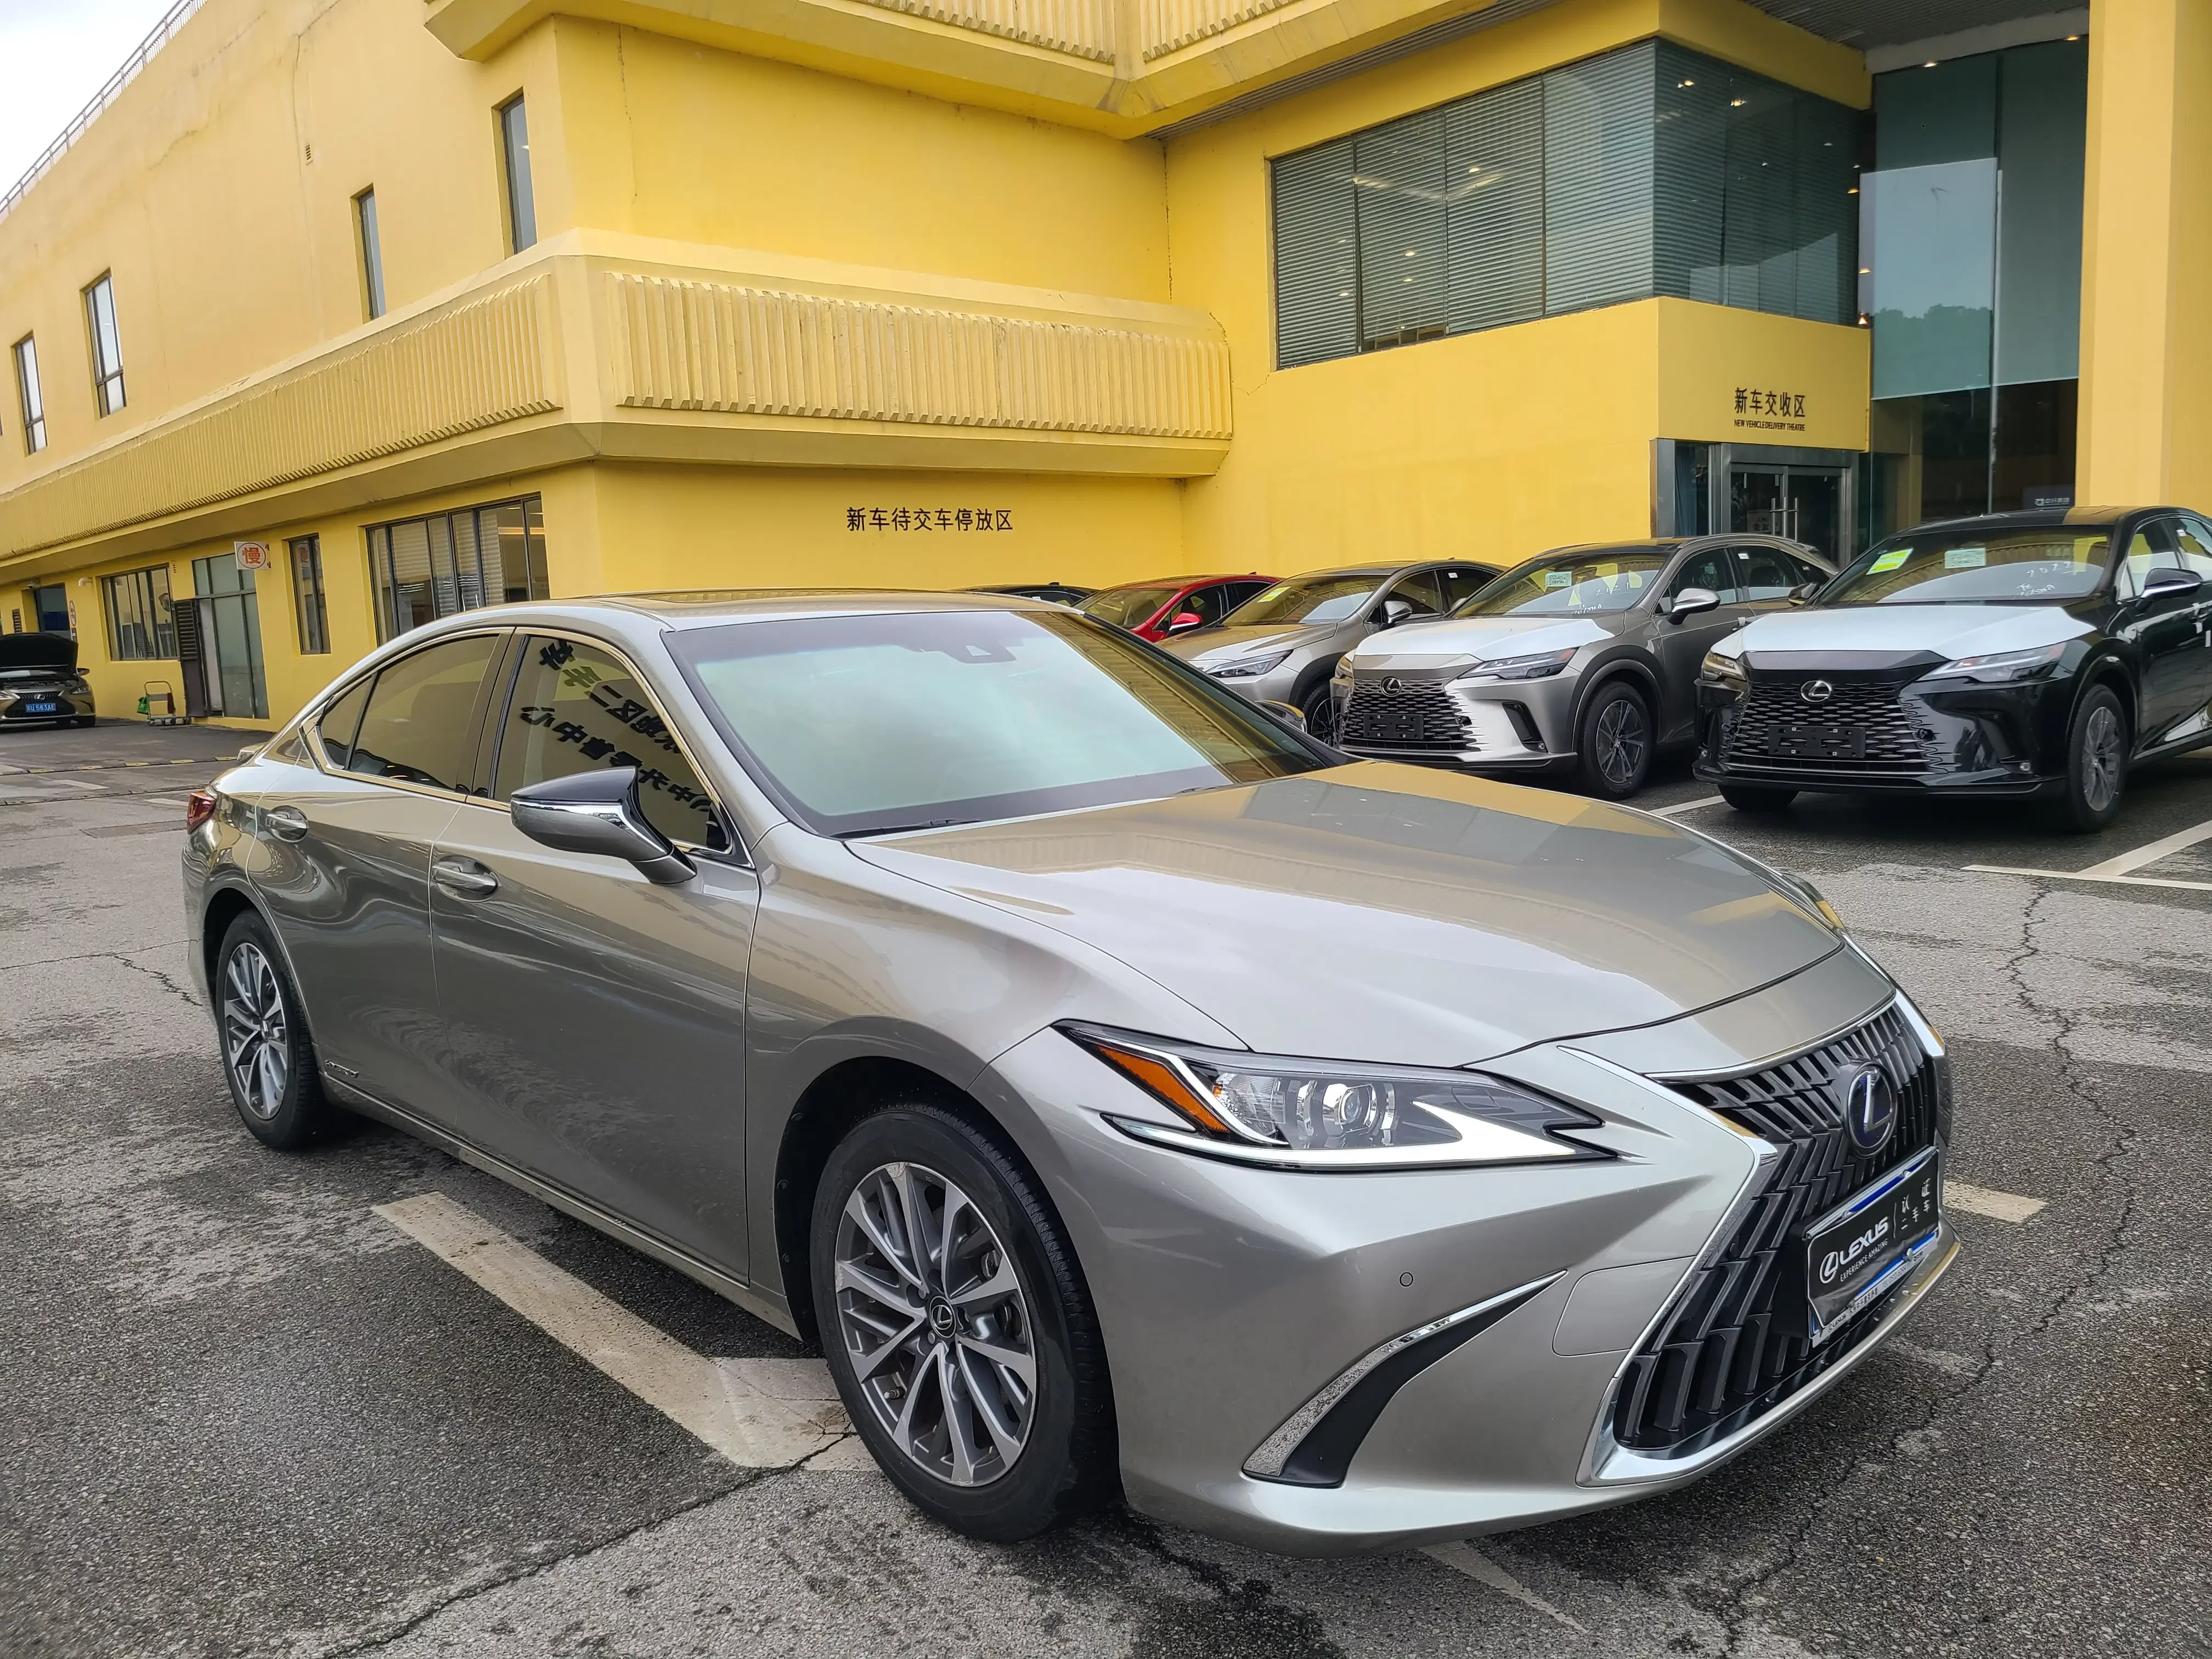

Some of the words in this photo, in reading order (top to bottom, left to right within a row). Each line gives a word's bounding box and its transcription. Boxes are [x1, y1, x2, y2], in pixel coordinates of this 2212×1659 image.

[1734, 387, 1805, 417] 新车交收区
[1734, 419, 1745, 427] NEW
[1746, 420, 1765, 428] VEHICLE
[1765, 421, 1786, 430] DELIVERY
[1786, 423, 1805, 431] THEATRE
[847, 507, 1013, 531] 新车待交车停放区
[242, 547, 261, 564] 慢
[1901, 1178, 1931, 1214] 认证
[1901, 1200, 1930, 1229] 二手车
[1839, 1216, 1888, 1265] LEXUS
[1840, 1255, 1868, 1282] EXPERIENCE
[1868, 1238, 1888, 1260] AMAZING
